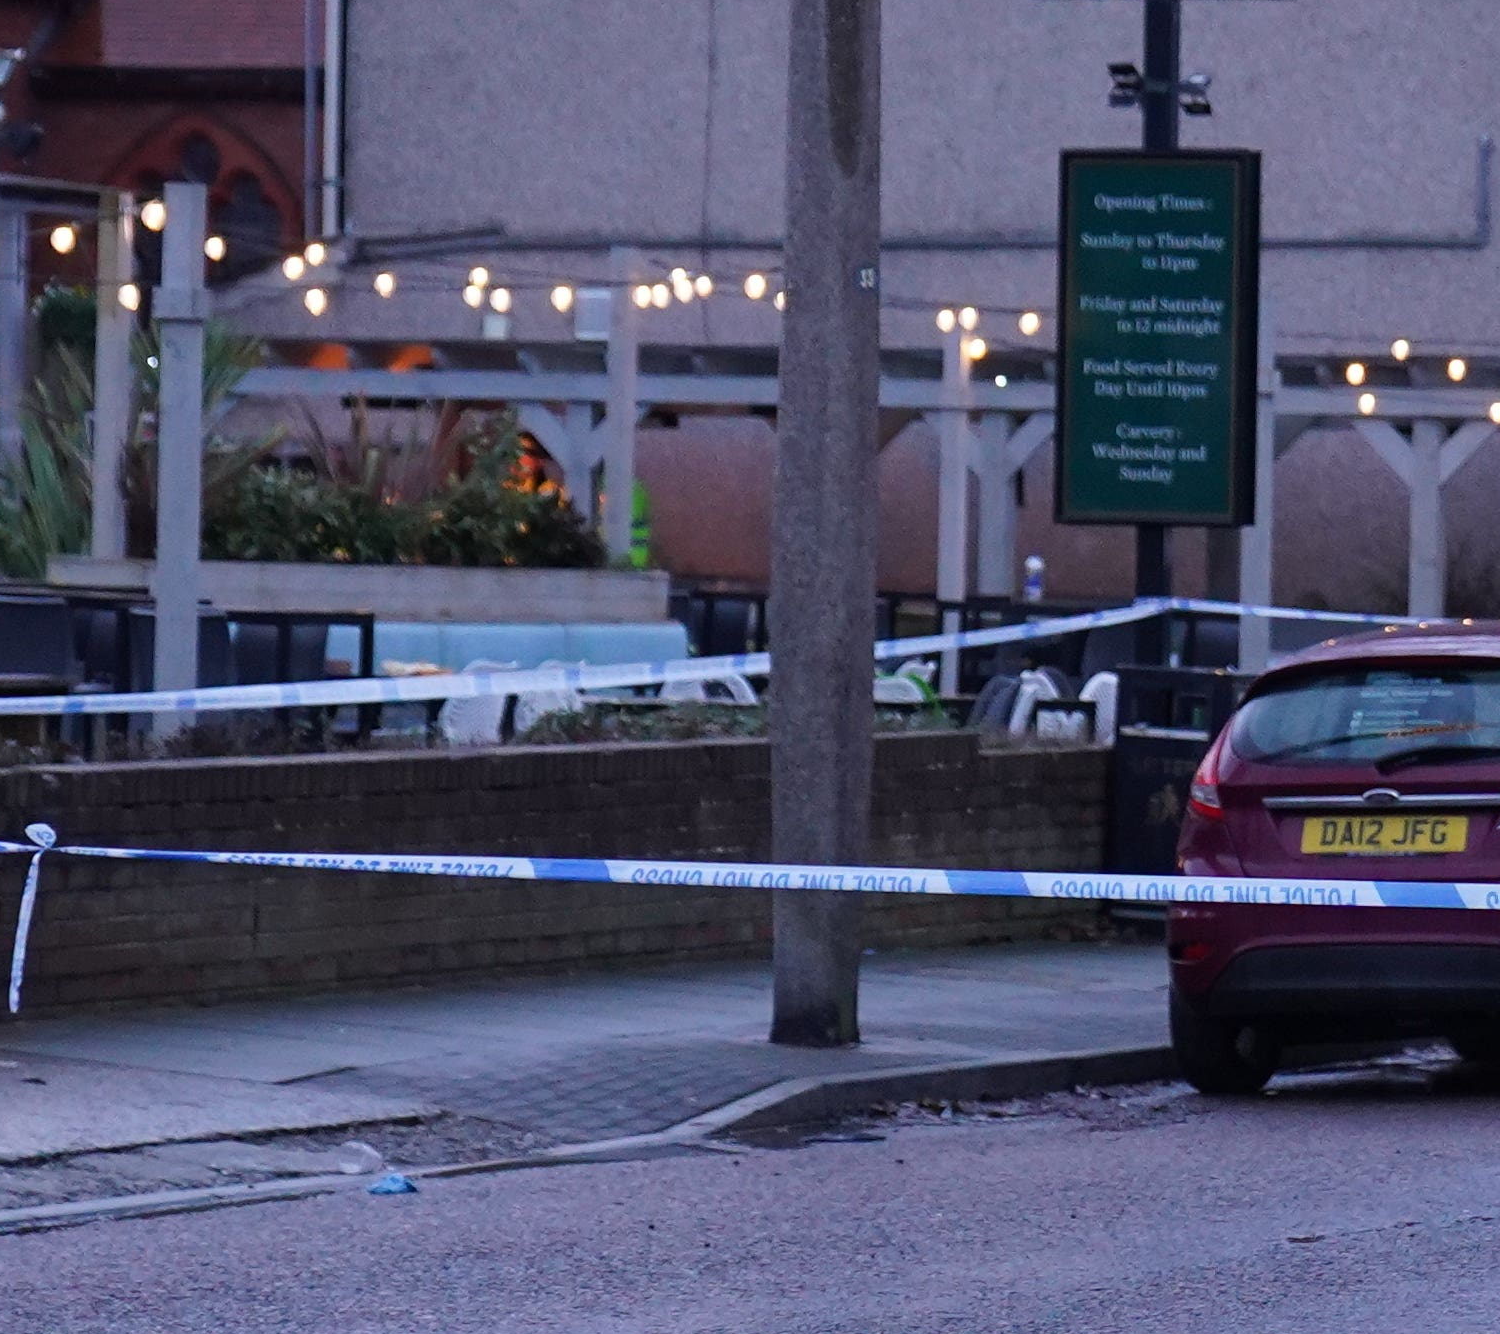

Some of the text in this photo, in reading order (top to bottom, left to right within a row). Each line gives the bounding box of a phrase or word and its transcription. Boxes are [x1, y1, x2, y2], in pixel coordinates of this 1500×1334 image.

[1093, 193, 1157, 213] Opening
[1156, 231, 1226, 253] Thursday
[1129, 296, 1157, 312] and
[1159, 295, 1225, 316] Saturday
[1082, 358, 1120, 375] Food
[1123, 358, 1174, 377] Served
[1094, 379, 1123, 400] Day
[1319, 819, 1448, 847] DA12 JFG
